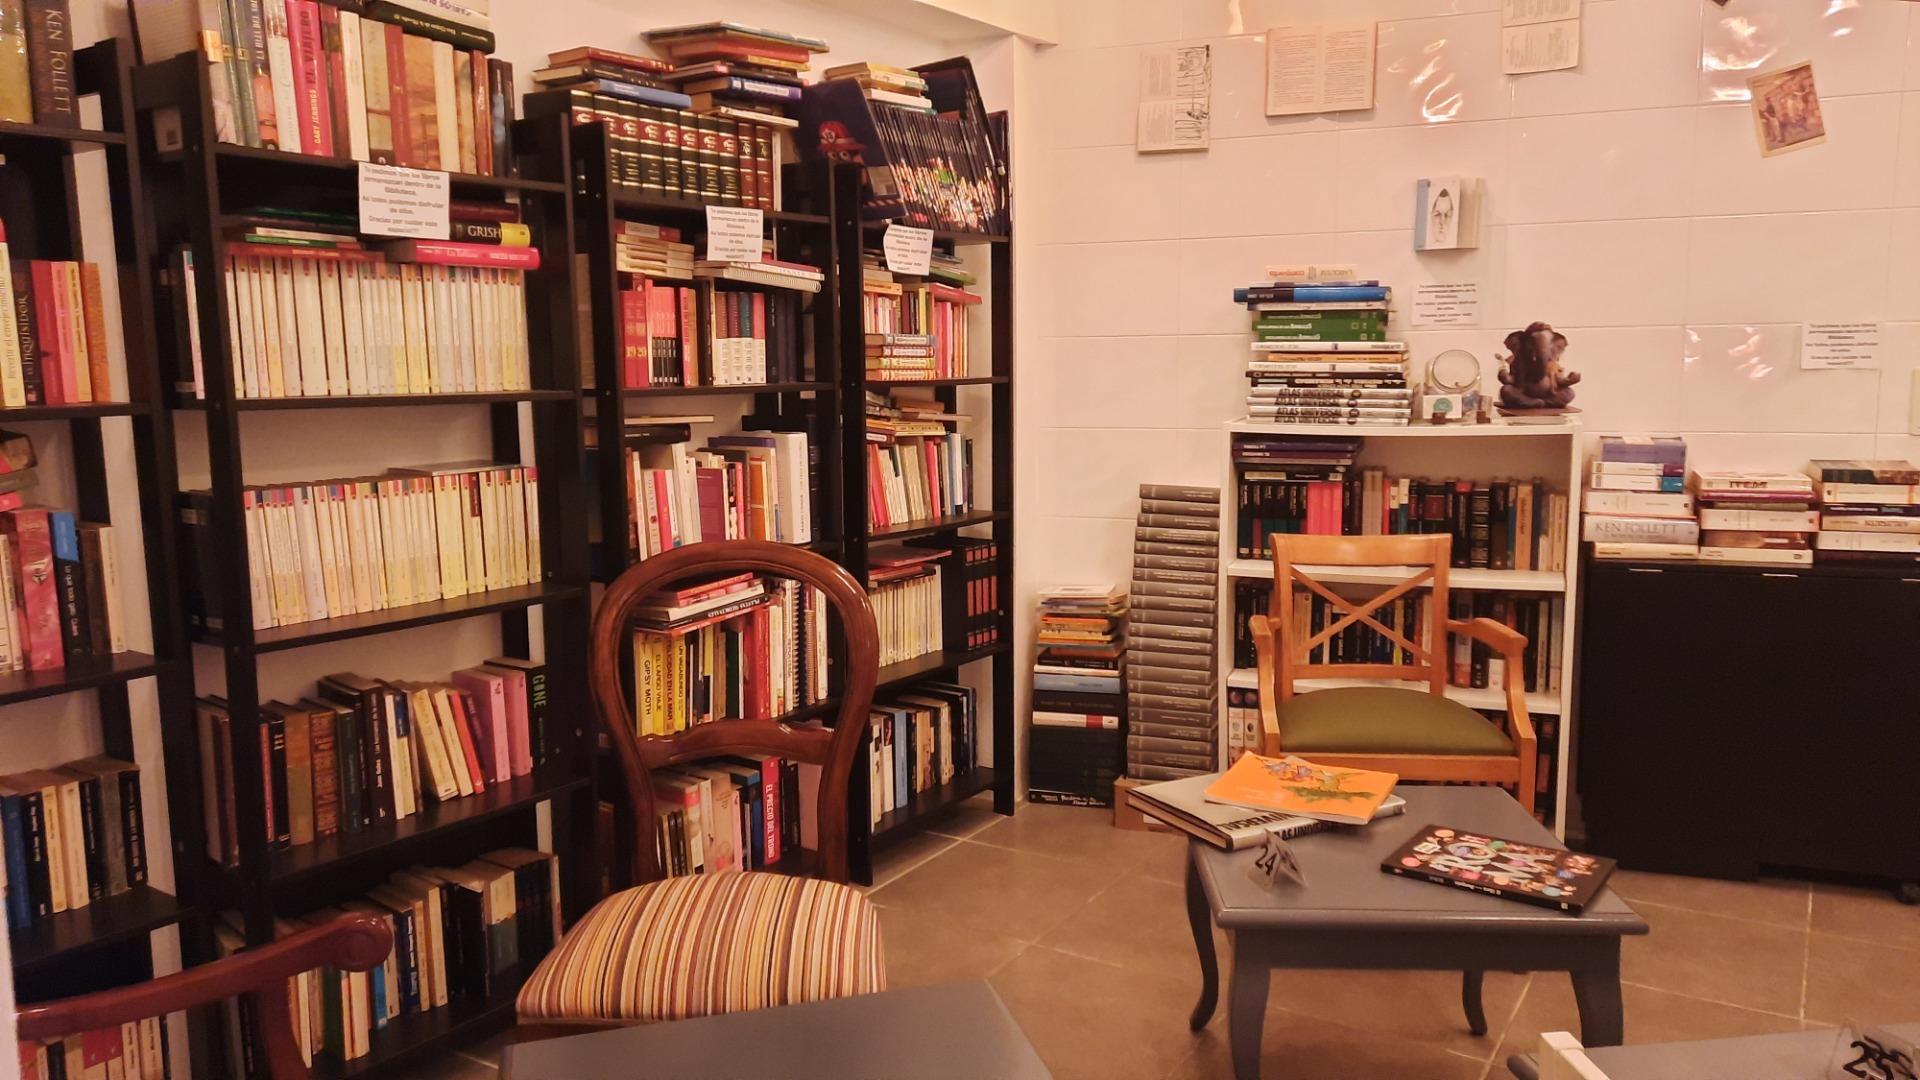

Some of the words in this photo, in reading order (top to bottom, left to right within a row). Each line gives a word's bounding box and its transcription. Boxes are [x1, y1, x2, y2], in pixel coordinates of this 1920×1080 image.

[45, 9, 64, 42] KEN
[300, 10, 315, 62] VIAJERO
[48, 49, 72, 115] FOLLETT
[309, 88, 321, 124] JENNINGS
[313, 126, 322, 144] GARY
[467, 224, 502, 238] GRISH
[18, 294, 34, 365] INQUISIDOR
[1279, 388, 1301, 398] ATLAS
[1277, 407, 1299, 416] ATLAS
[1595, 522, 1621, 533] KEN
[1623, 523, 1677, 534] FOLLETT
[644, 659, 652, 687] GIPSY
[644, 688, 652, 715] MOTH
[766, 783, 774, 794] EL
[766, 793, 774, 820] PRECIO
[766, 820, 774, 834] DEL
[767, 834, 775, 858] TRONO
[1255, 846, 1277, 876] 24
